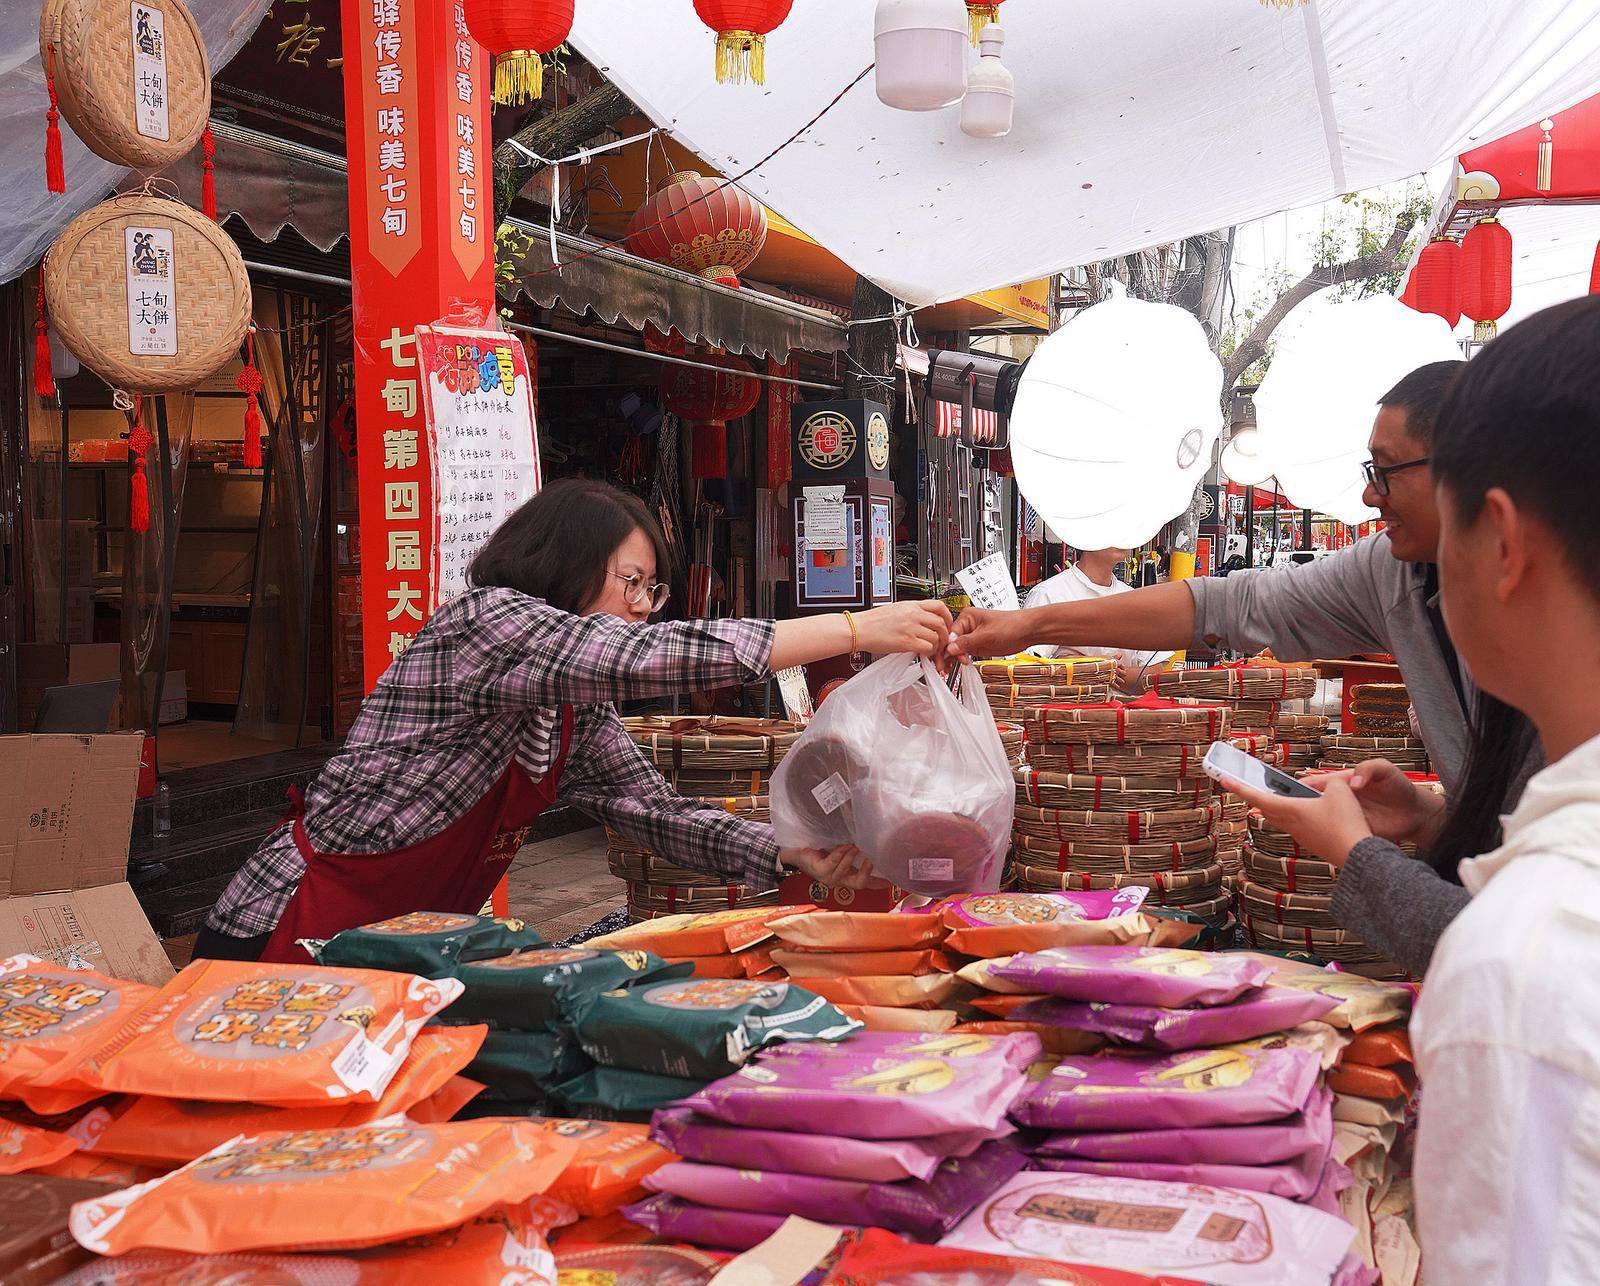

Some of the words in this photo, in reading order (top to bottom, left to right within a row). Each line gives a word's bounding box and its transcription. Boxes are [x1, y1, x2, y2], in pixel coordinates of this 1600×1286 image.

[140, 70, 162, 91] 七甸
[376, 106, 407, 237] 味美七甸
[455, 113, 477, 244] 味美七甸
[135, 290, 168, 309] 七甸
